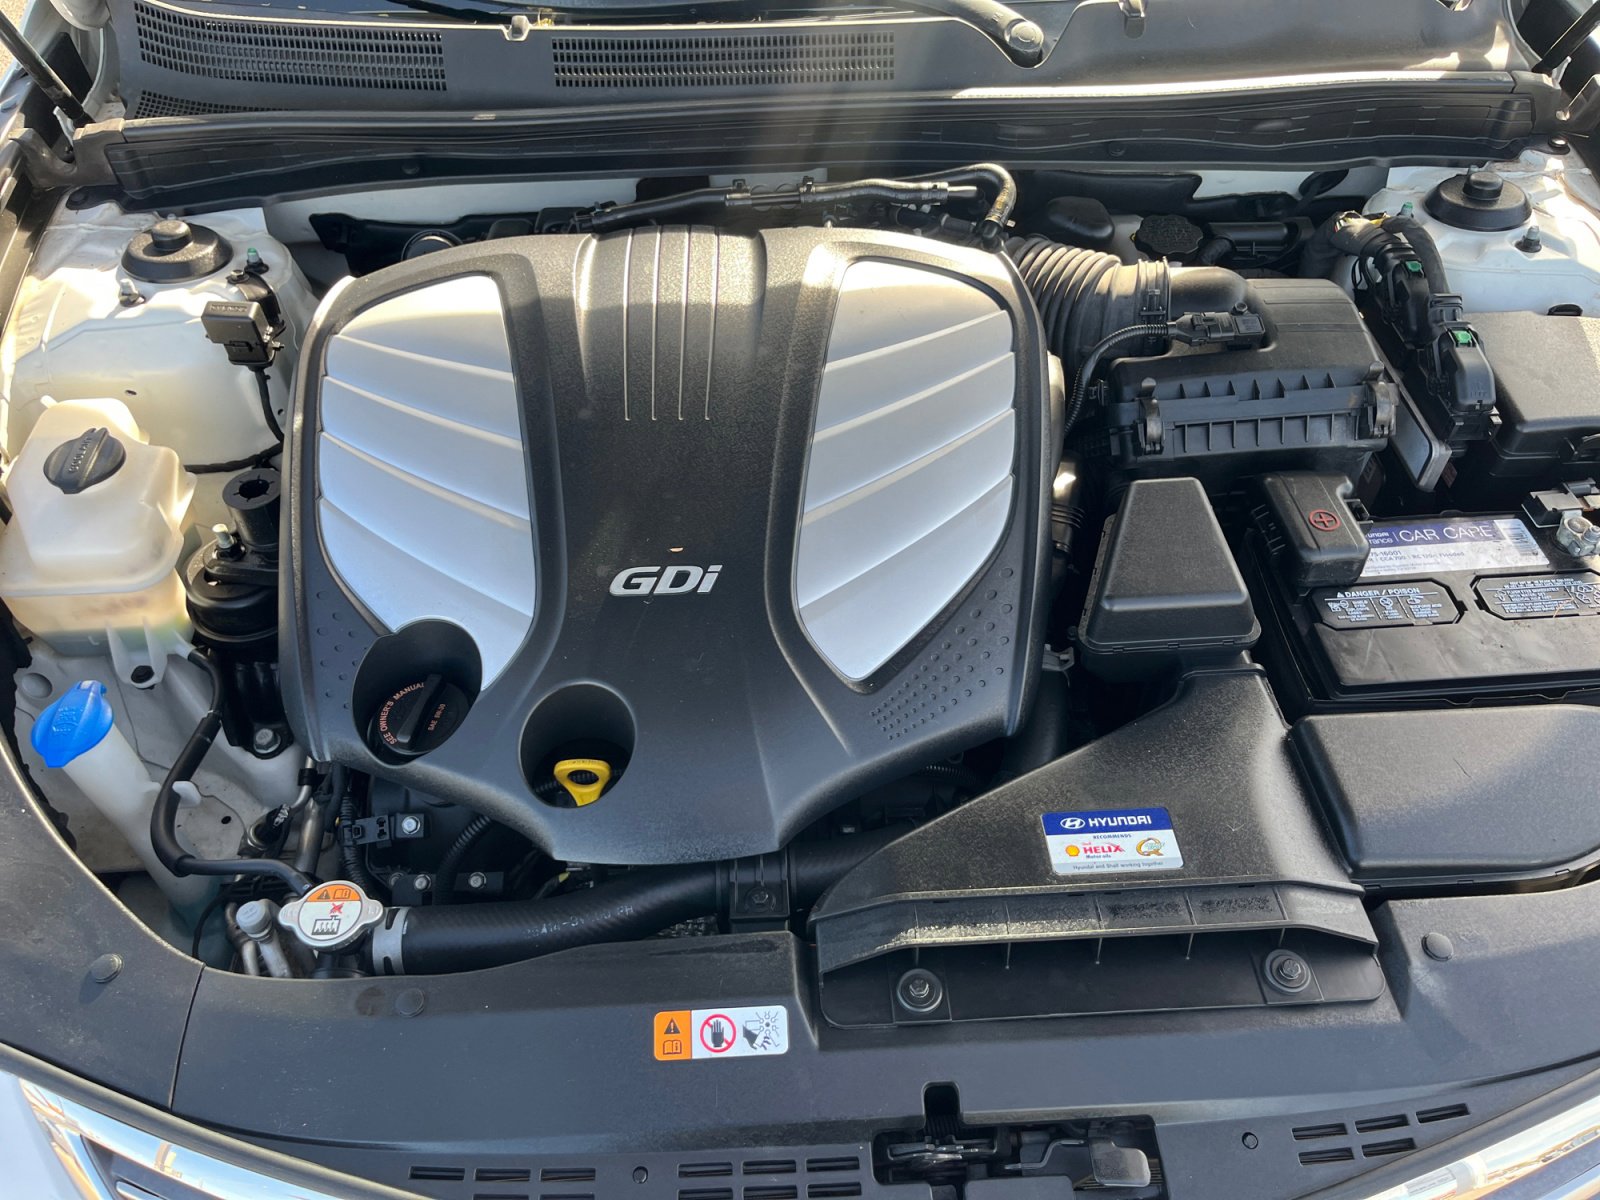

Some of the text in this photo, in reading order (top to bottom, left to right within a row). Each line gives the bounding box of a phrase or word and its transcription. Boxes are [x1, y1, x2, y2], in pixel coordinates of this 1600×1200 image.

[1399, 523, 1495, 542] CAR CARE
[609, 564, 723, 596] GDi
[1344, 590, 1380, 598] DANGER
[1388, 587, 1420, 595] POISON
[379, 700, 395, 732] OWNER'S
[383, 732, 398, 745] SEE
[1088, 815, 1152, 827] HYUNDAI
[1083, 844, 1124, 854] HELIX
